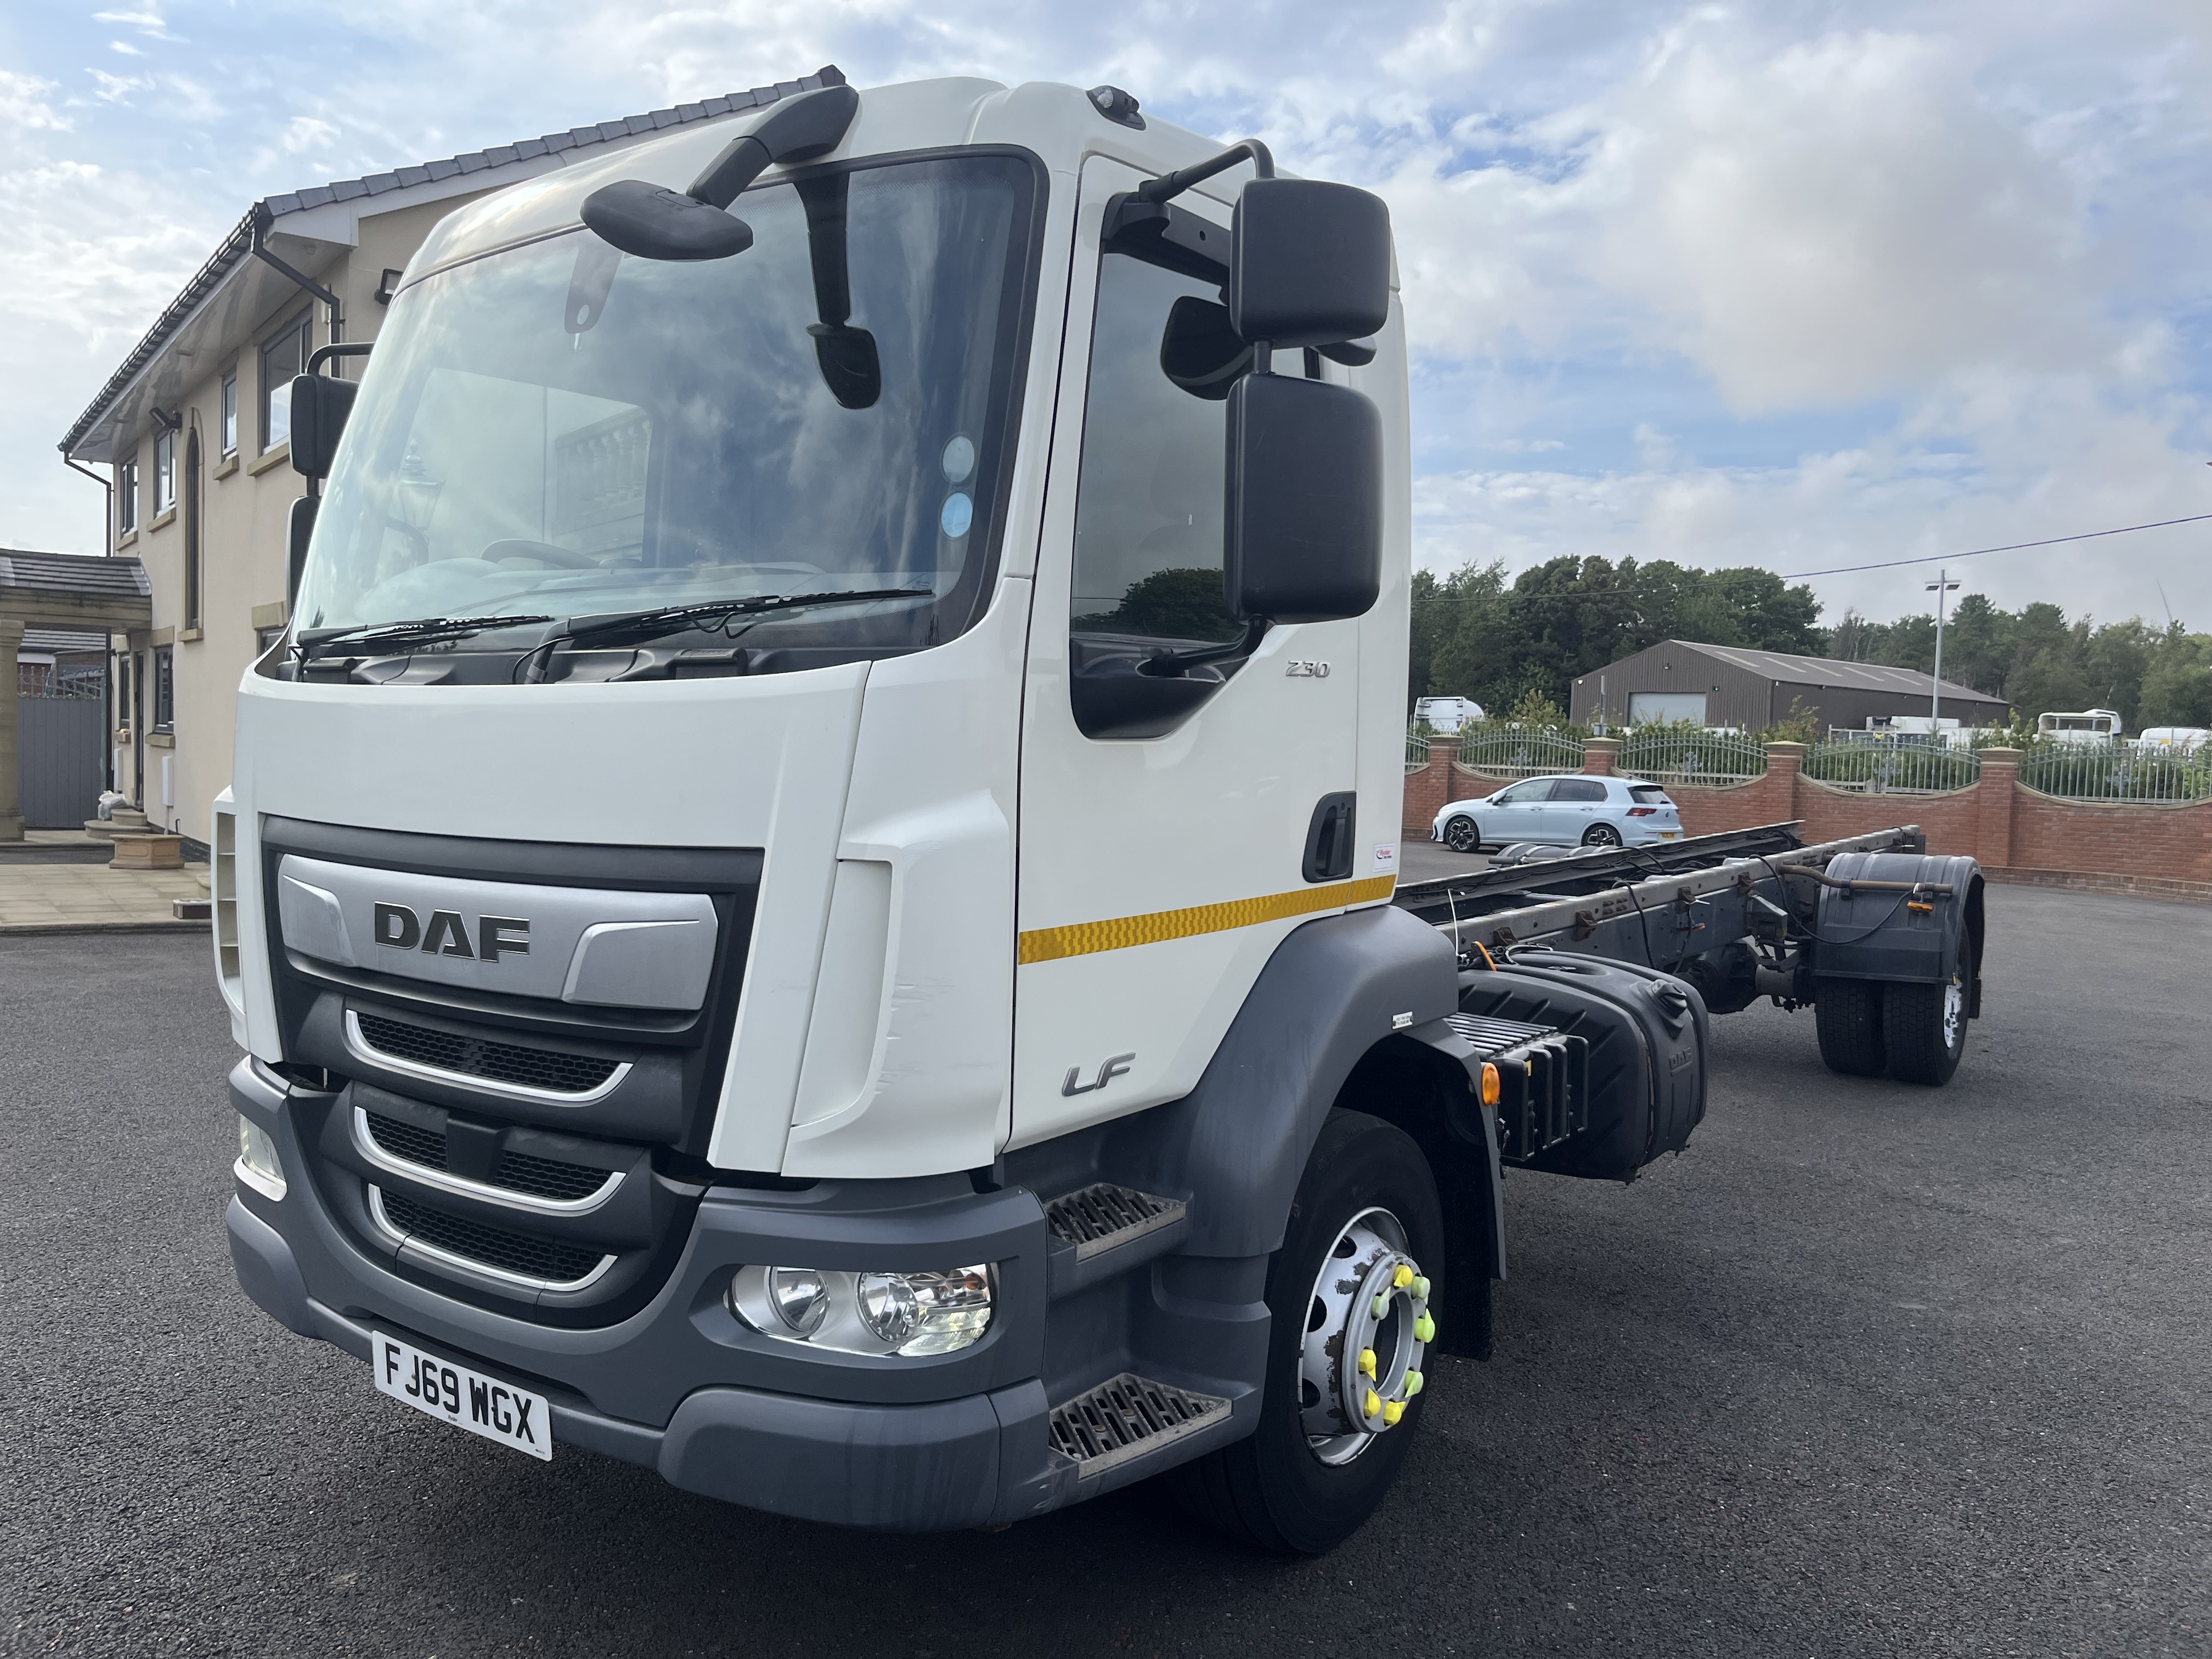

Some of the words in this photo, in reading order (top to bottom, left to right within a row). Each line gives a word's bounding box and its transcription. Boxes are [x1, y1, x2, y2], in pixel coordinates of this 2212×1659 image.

[1285, 660, 1331, 678] 230
[374, 900, 531, 963] DAF
[1062, 1052, 1136, 1097] LF
[1668, 1047, 1692, 1070] DAF
[385, 1342, 460, 1414] FJ69
[469, 1376, 535, 1444] WGX
